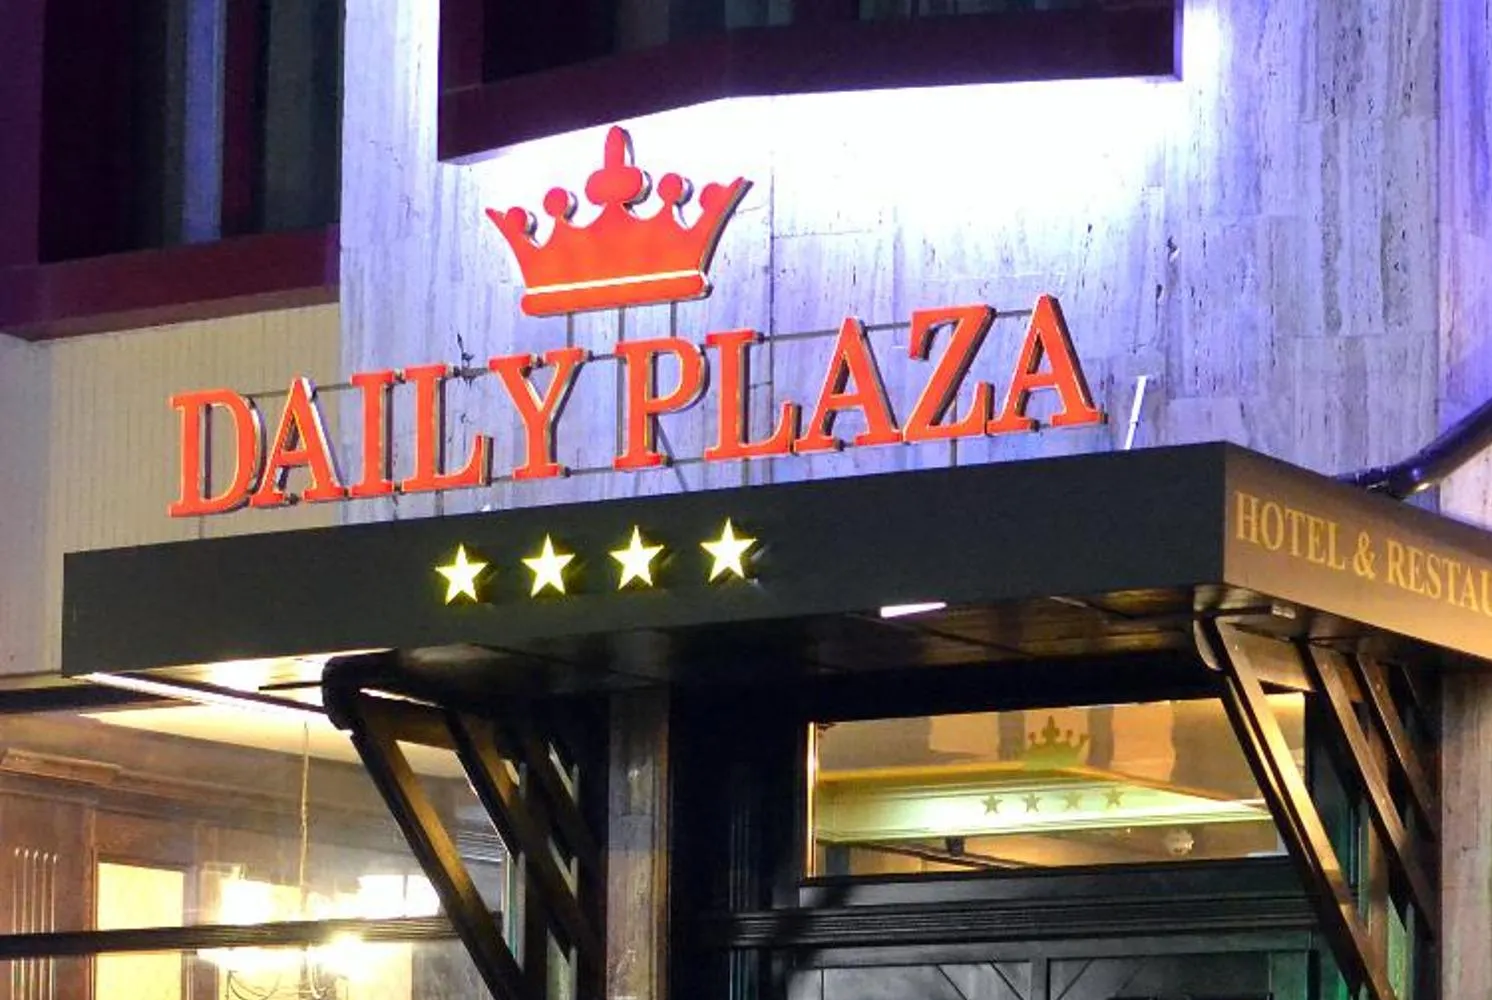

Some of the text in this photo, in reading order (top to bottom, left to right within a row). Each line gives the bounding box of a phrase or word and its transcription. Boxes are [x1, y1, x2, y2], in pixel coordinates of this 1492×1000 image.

[169, 294, 1104, 518] DAILY PLAZA
[1234, 492, 1346, 570] HOTEL
[1352, 531, 1378, 581] &
